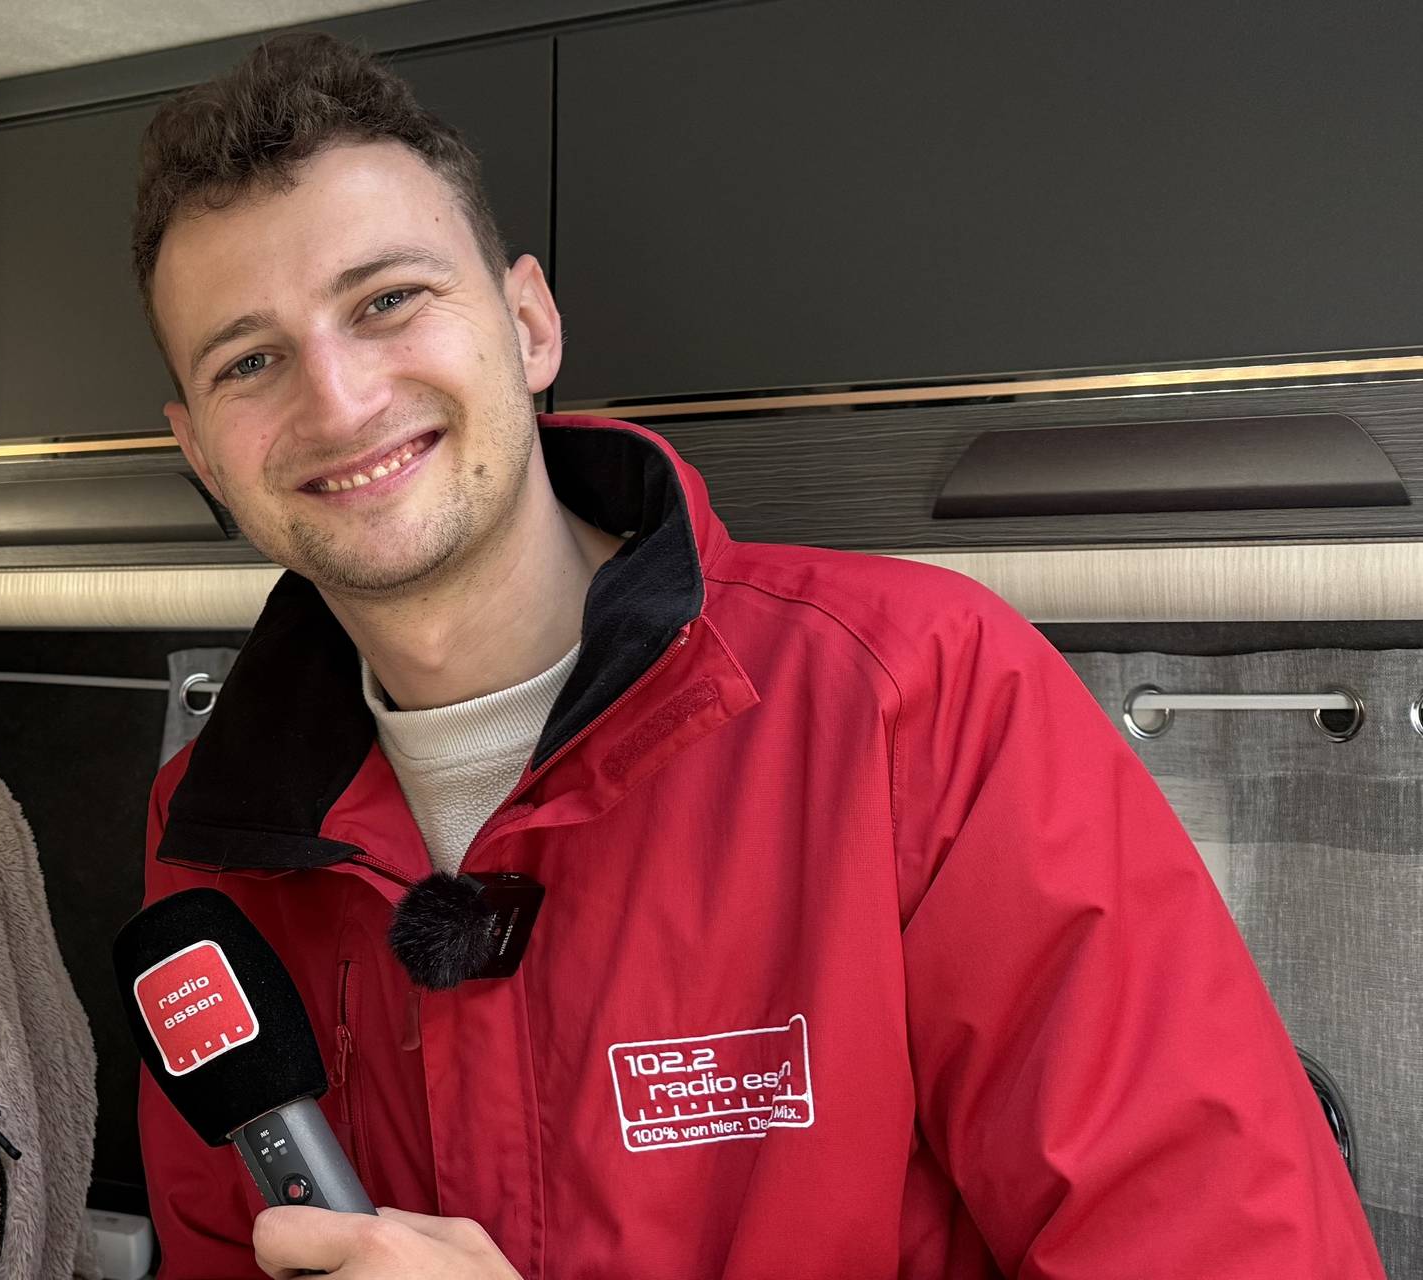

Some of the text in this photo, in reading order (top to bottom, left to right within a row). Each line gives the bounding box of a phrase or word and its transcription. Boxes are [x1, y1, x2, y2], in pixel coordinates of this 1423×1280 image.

[158, 976, 210, 1009] radio
[164, 992, 223, 1029] essen
[623, 1047, 718, 1077] 102.2
[648, 1070, 737, 1100] radio
[632, 1127, 679, 1144] 100%
[681, 1123, 709, 1139] von
[711, 1118, 744, 1136] hier.
[773, 1105, 802, 1120] Mix.
